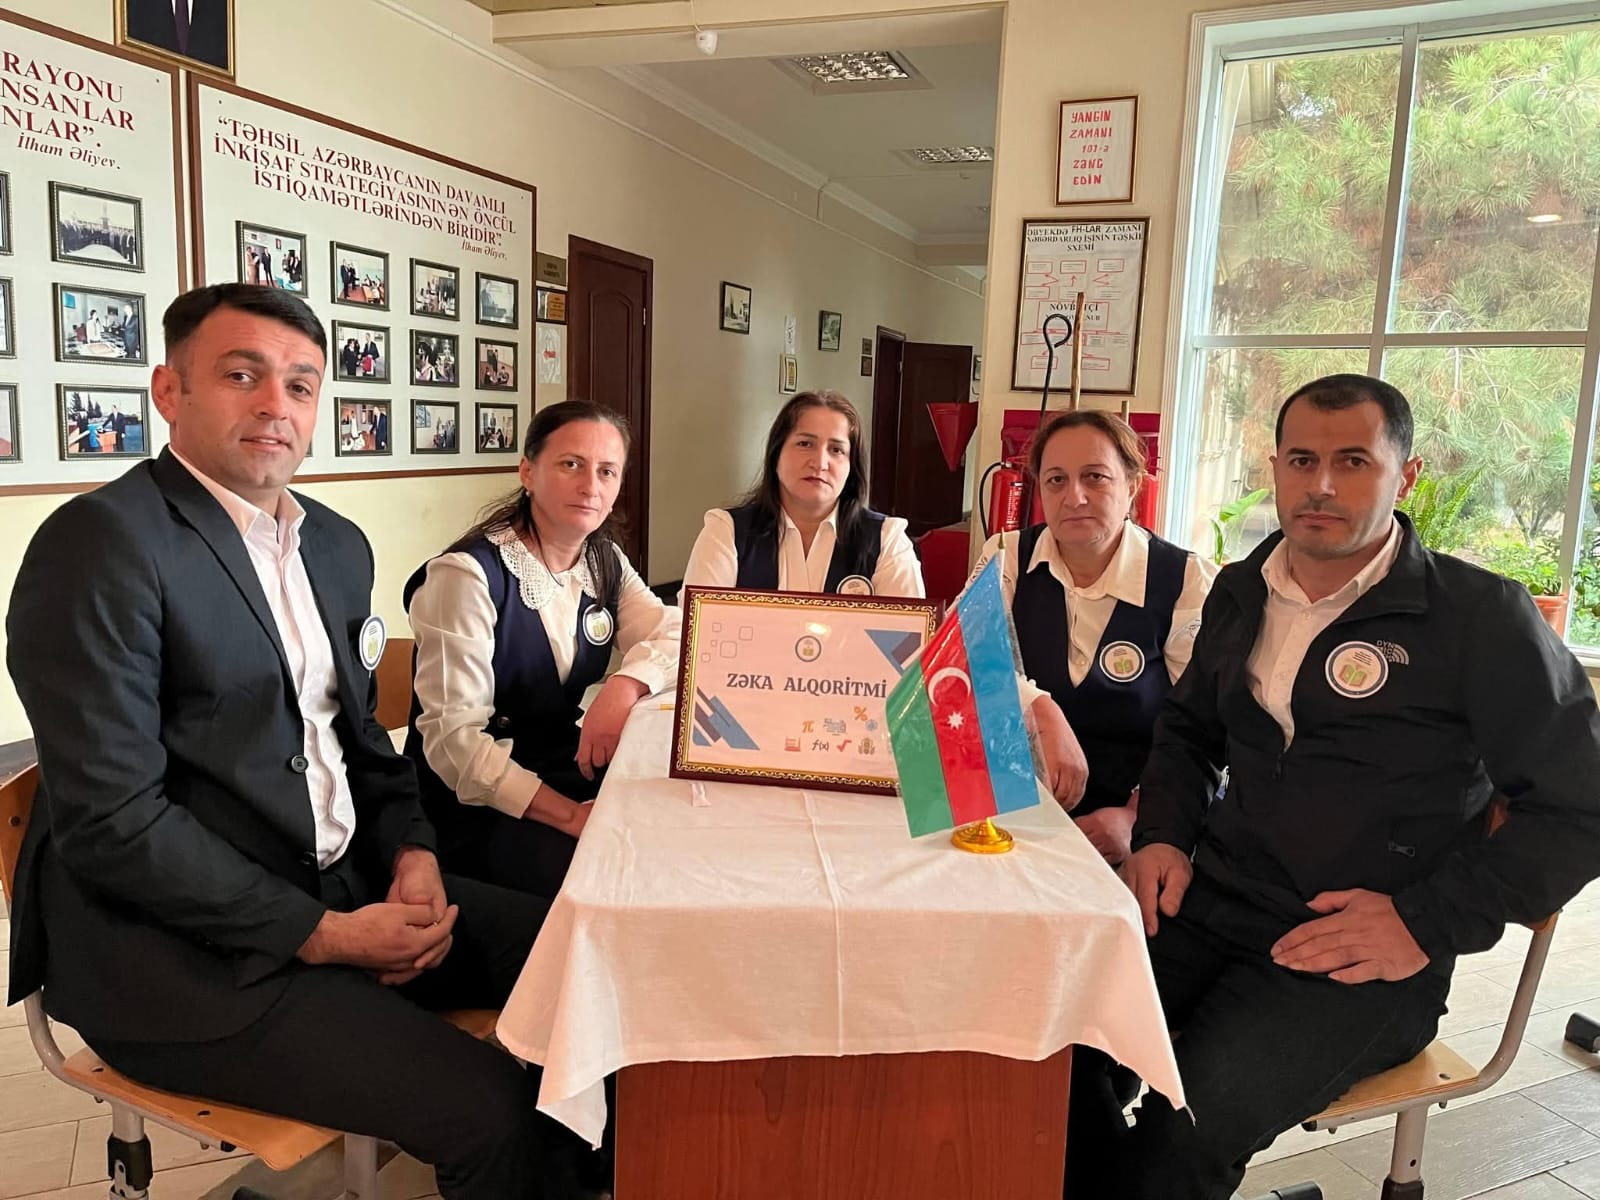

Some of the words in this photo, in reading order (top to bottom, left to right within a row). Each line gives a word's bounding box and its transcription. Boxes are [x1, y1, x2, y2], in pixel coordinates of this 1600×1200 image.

[2, 50, 122, 103] RAYONU
[17, 132, 63, 157] İlham
[1069, 127, 1112, 139] ZAMANI
[214, 132, 295, 173] İNKİŞAF
[300, 161, 446, 214] STRATEGİYASININ
[449, 203, 469, 221] ƏN
[474, 208, 516, 234] ÖNCÜL
[254, 165, 443, 232] İSTİQAMƏTLƏRİNDƏN
[313, 146, 440, 195] AZƏRBAYCANIN
[447, 184, 506, 215] DAVAMLI
[1071, 225, 1101, 233] FH-LAR
[1105, 223, 1141, 233] ZAMANI
[726, 673, 773, 690] ZƏKA
[784, 676, 887, 699] ALQORİTMİ
